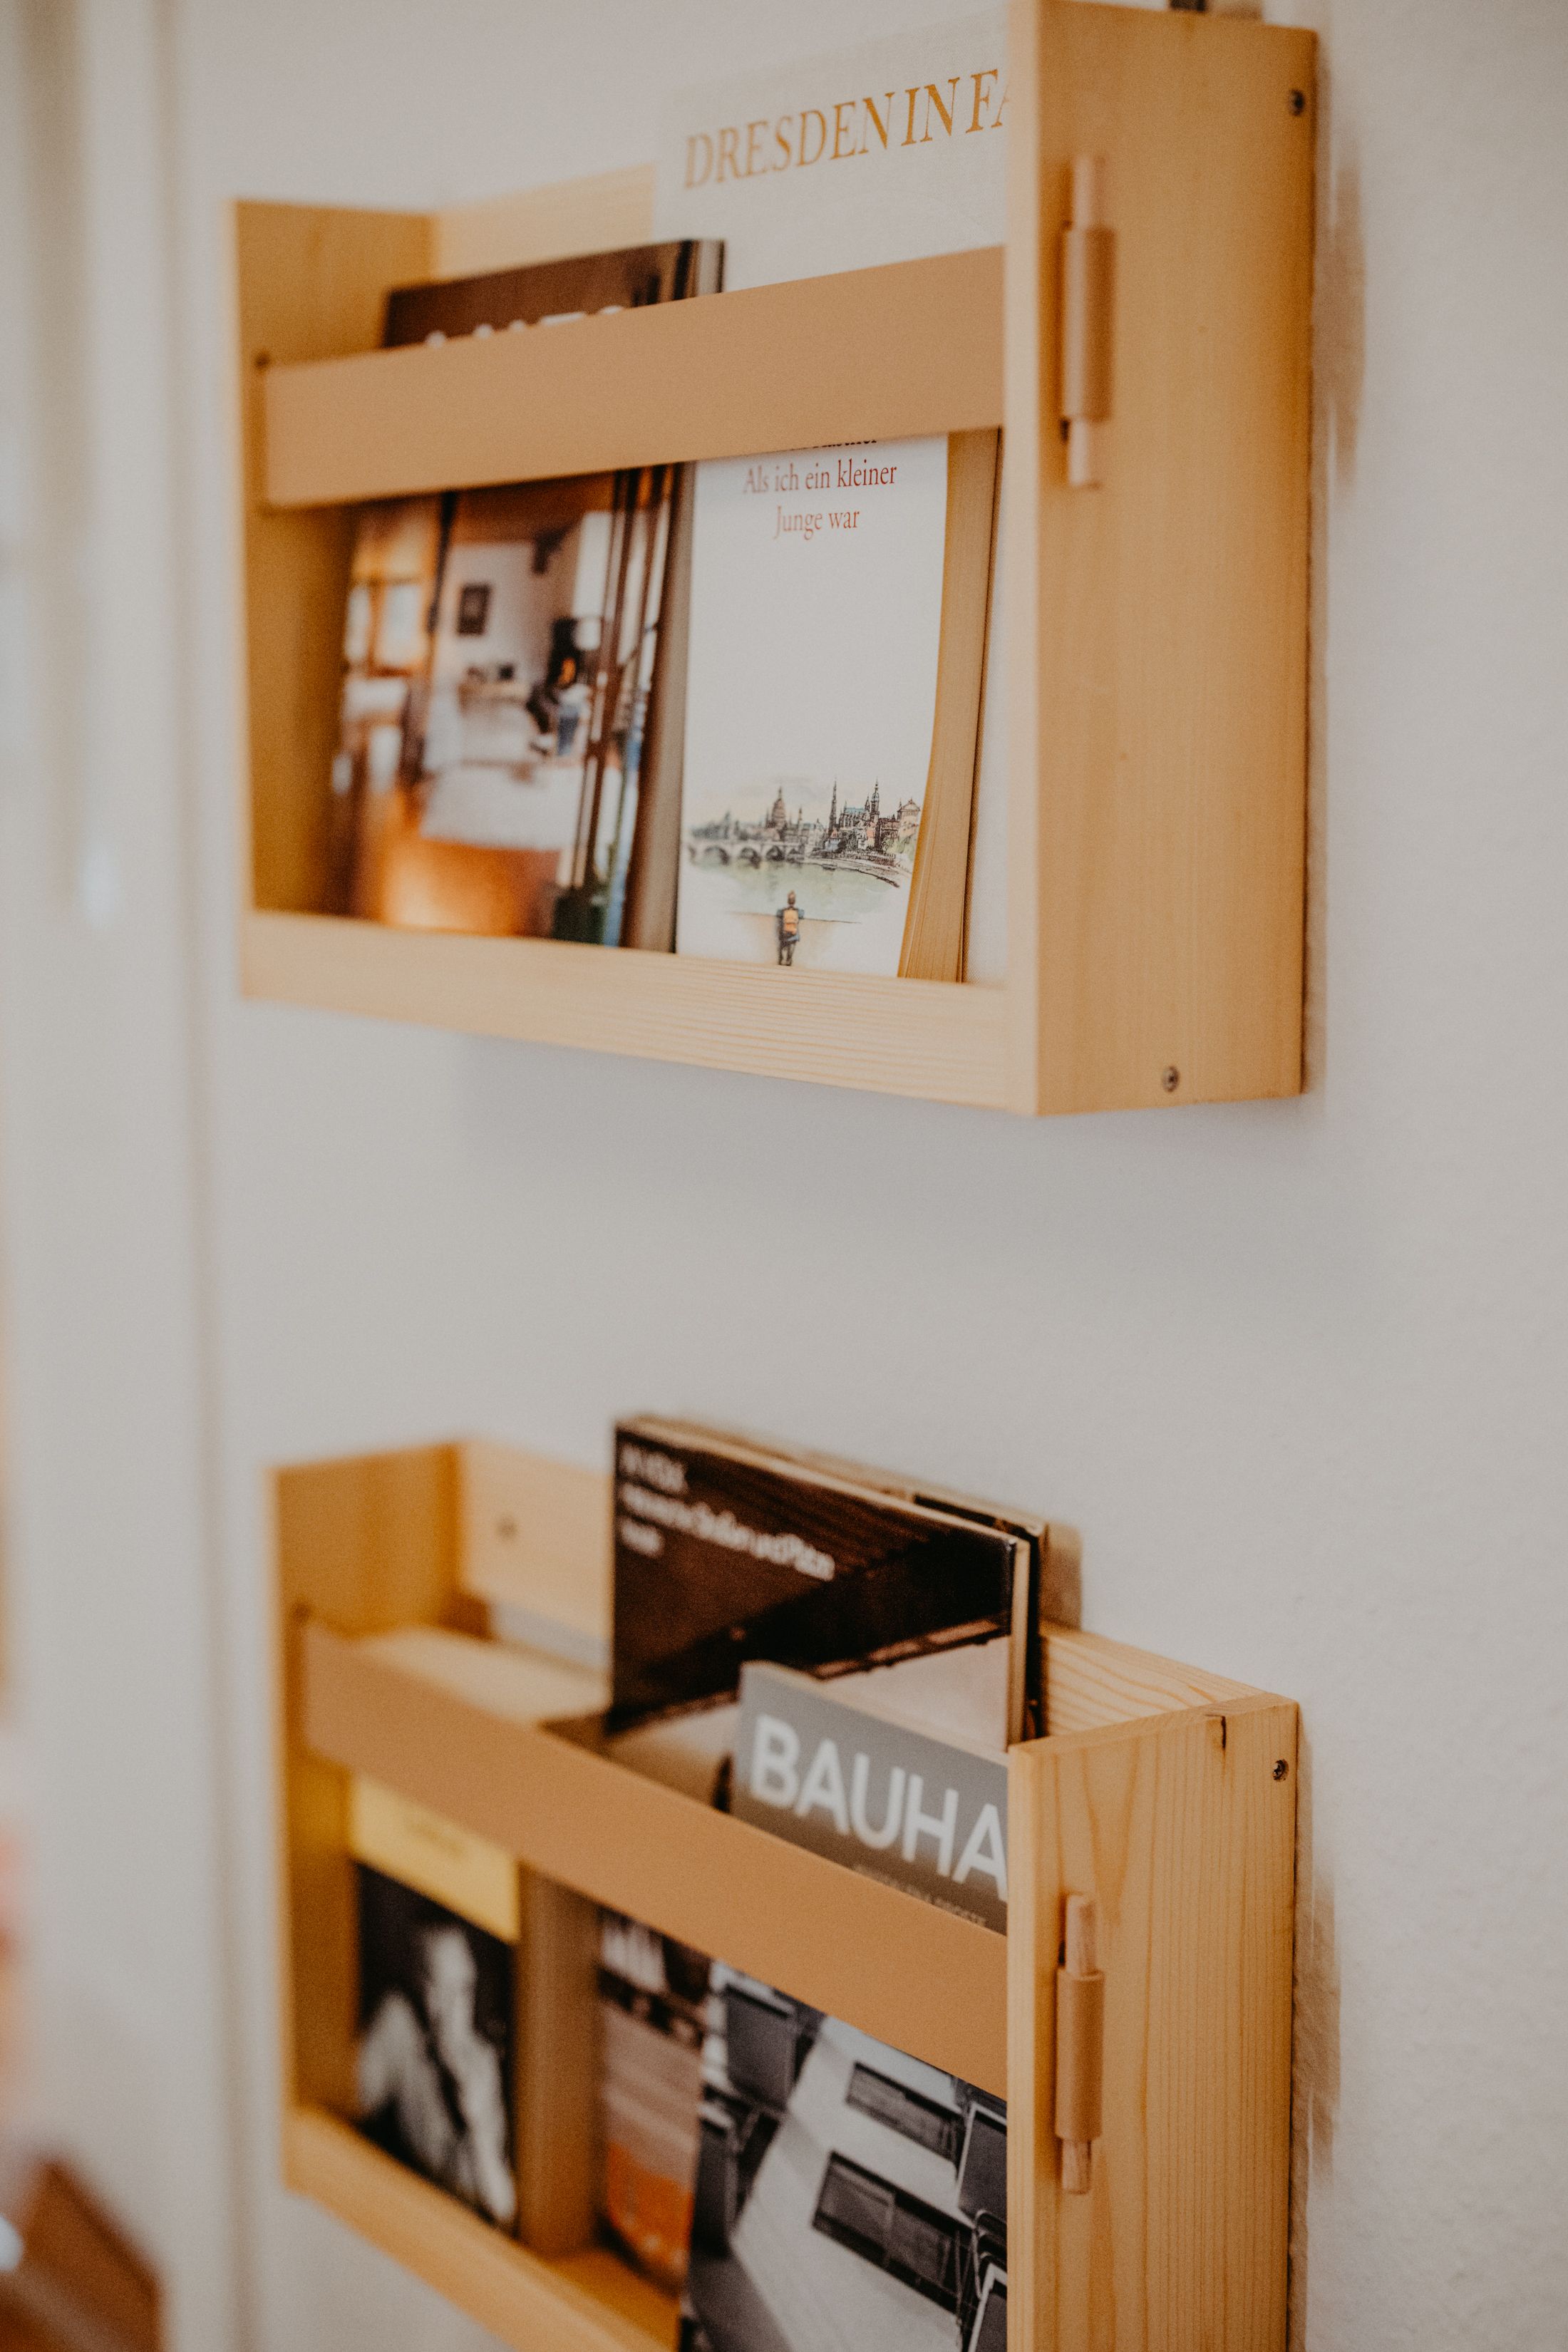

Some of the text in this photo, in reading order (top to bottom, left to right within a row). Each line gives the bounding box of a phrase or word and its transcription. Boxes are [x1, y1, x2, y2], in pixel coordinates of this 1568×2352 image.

[684, 92, 895, 190] DRESDEN
[901, 77, 960, 147] IN
[743, 458, 897, 494] Als ich ein kleiner
[773, 505, 860, 540] Junge war
[749, 1713, 1008, 1904] BAUHA
